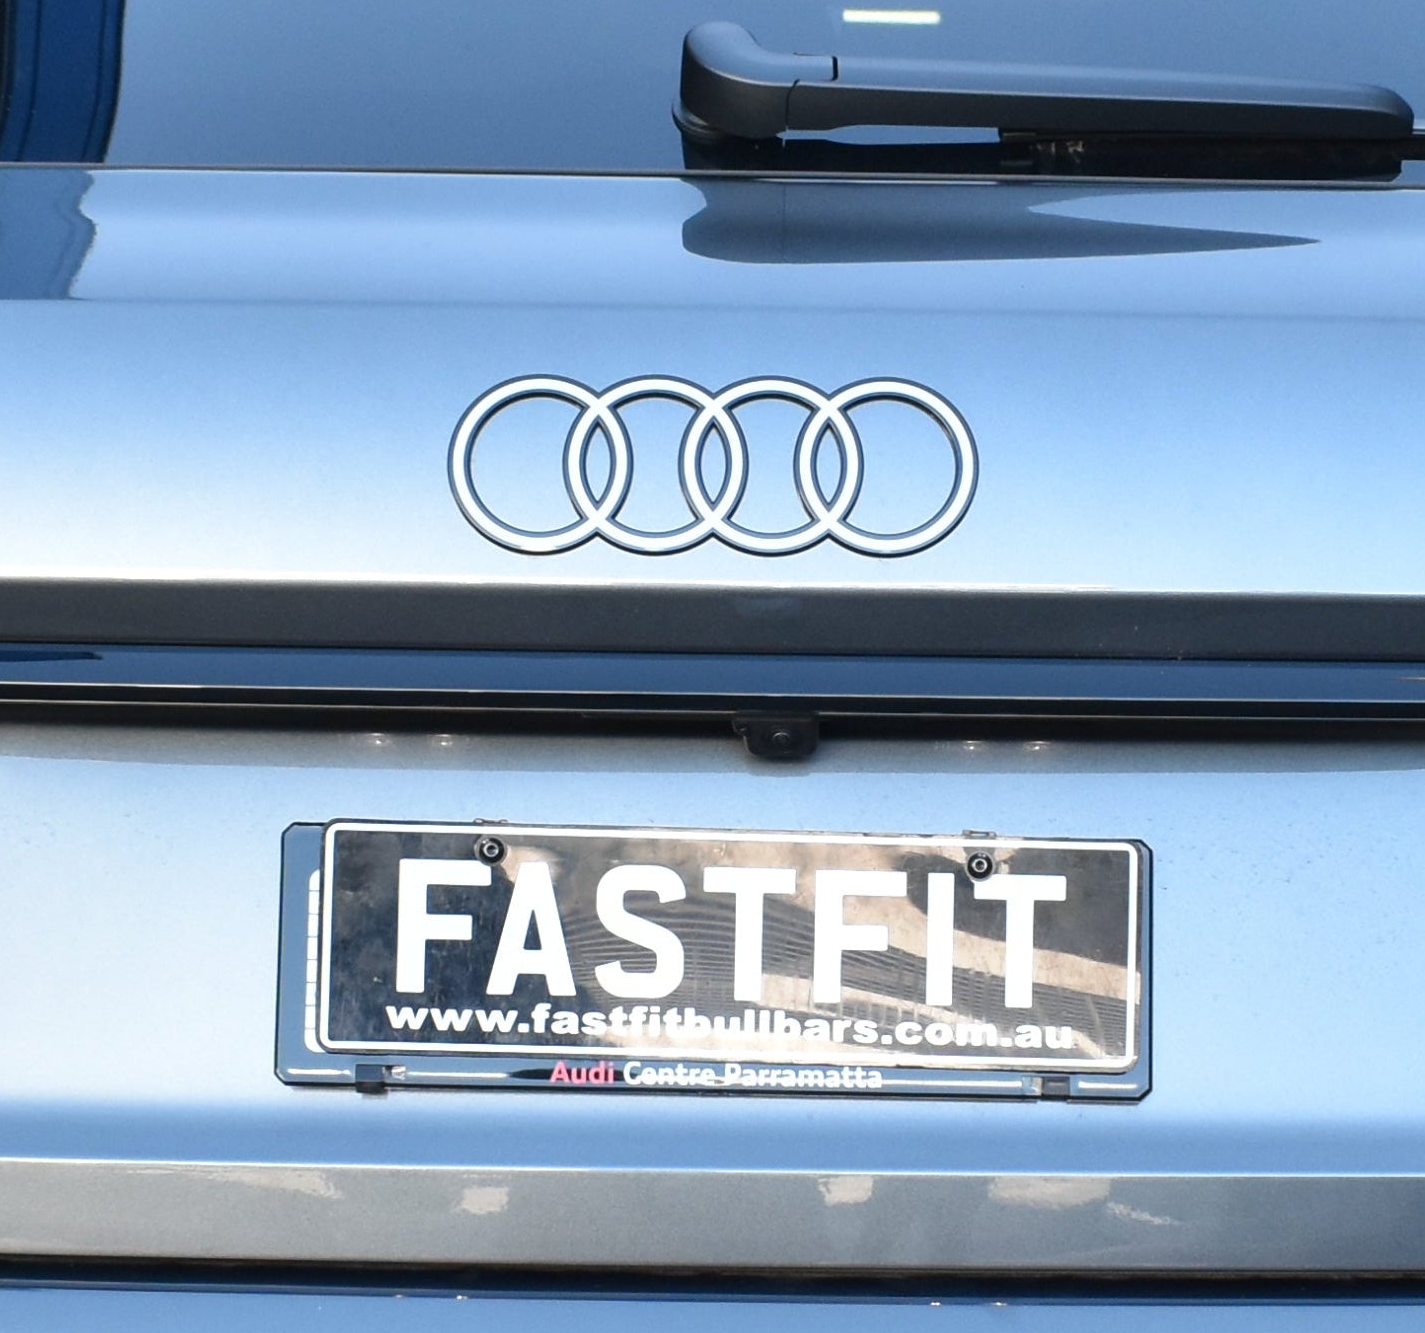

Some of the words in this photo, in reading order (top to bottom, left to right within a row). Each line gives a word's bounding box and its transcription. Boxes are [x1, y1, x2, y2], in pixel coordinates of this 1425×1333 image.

[394, 857, 1067, 1009] FASTFIT
[384, 1001, 1076, 1049] www.fastfitbullbars.com.au
[550, 1060, 615, 1084] Audi
[623, 1061, 716, 1087] Centre
[723, 1063, 883, 1089] Parramatta
